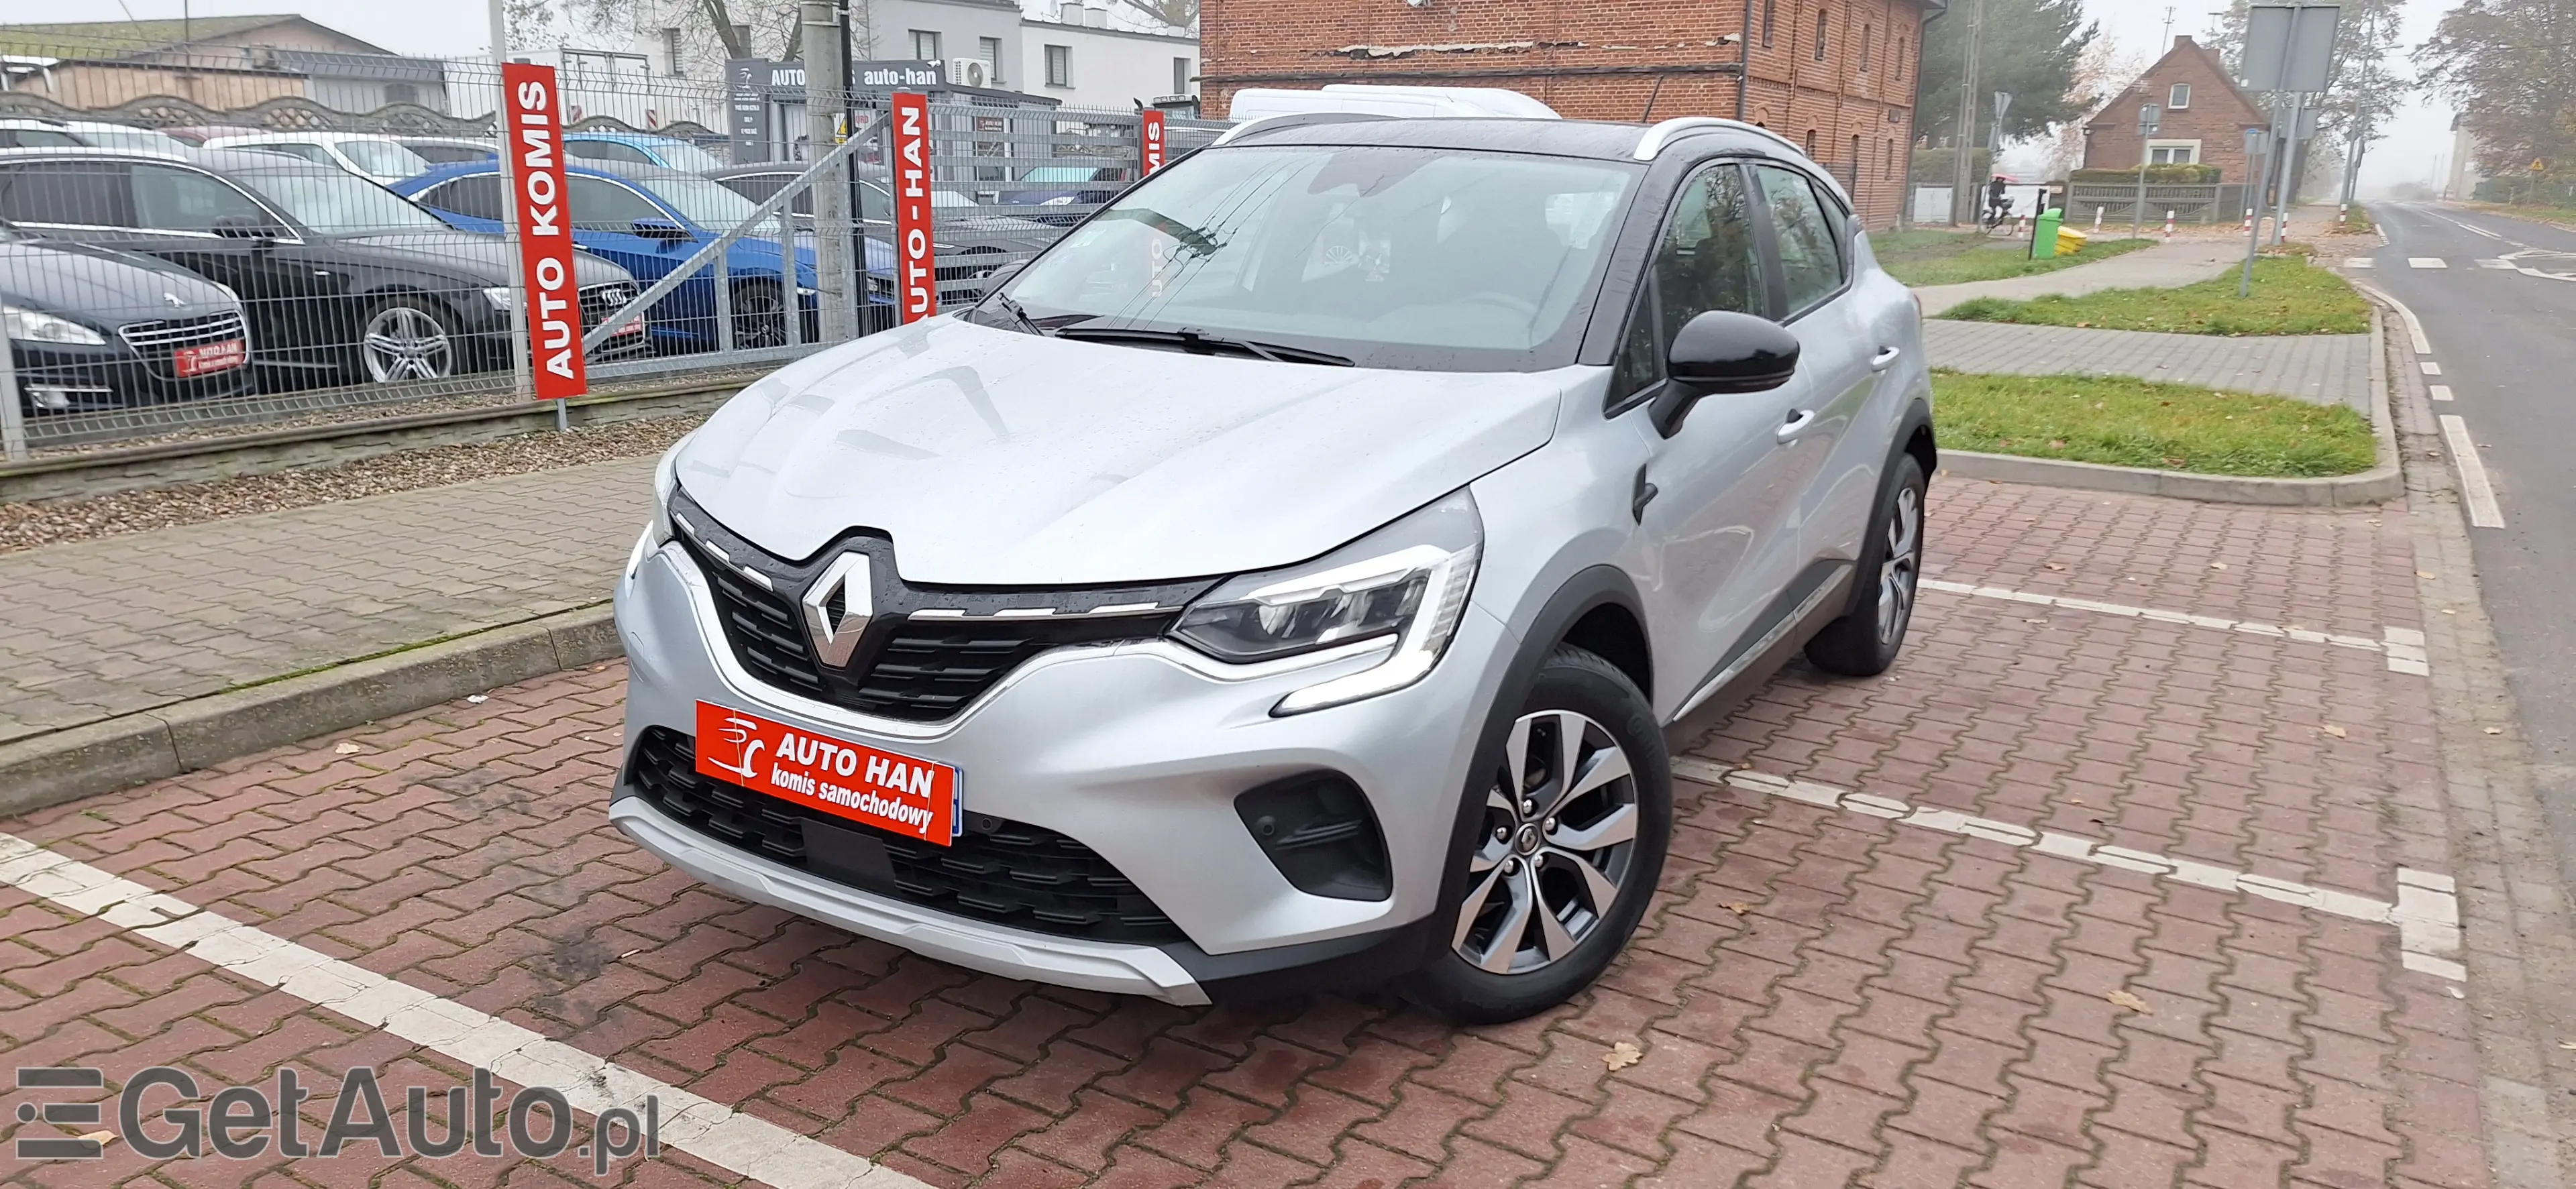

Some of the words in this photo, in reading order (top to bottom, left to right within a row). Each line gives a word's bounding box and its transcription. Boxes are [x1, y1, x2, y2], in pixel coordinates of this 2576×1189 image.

[771, 69, 806, 86] AUTO
[864, 68, 937, 85] auto-han
[518, 81, 559, 235] KOMIS
[901, 107, 924, 197] HAN
[1148, 122, 1160, 175] MIS
[908, 229, 928, 321] UTO
[1151, 238, 1163, 297] UTO
[537, 258, 574, 380] AUTO
[771, 762, 816, 796] komis
[819, 783, 934, 834] samochodowy
[776, 733, 857, 777] AUTO
[865, 756, 934, 799] HAN
